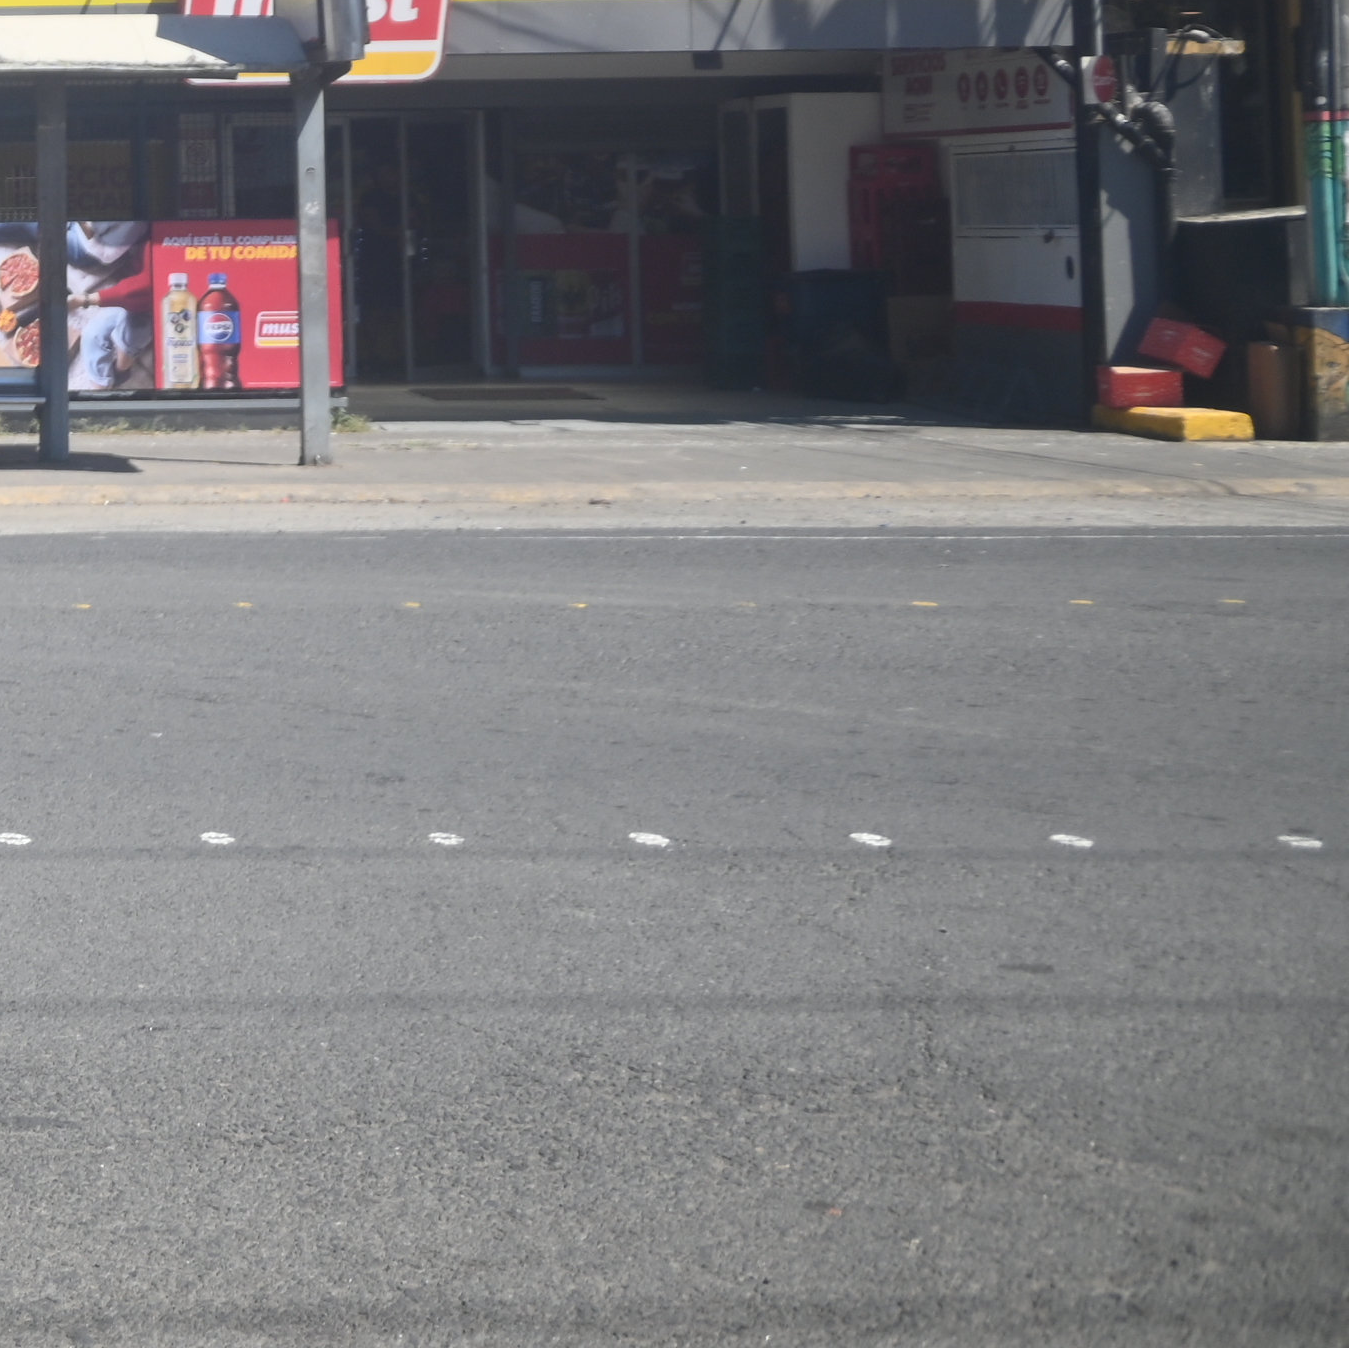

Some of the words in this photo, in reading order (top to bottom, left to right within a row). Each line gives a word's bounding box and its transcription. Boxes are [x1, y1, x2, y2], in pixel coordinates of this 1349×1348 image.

[222, 235, 235, 246] EL
[185, 246, 207, 260] DE
[208, 246, 232, 260] TU
